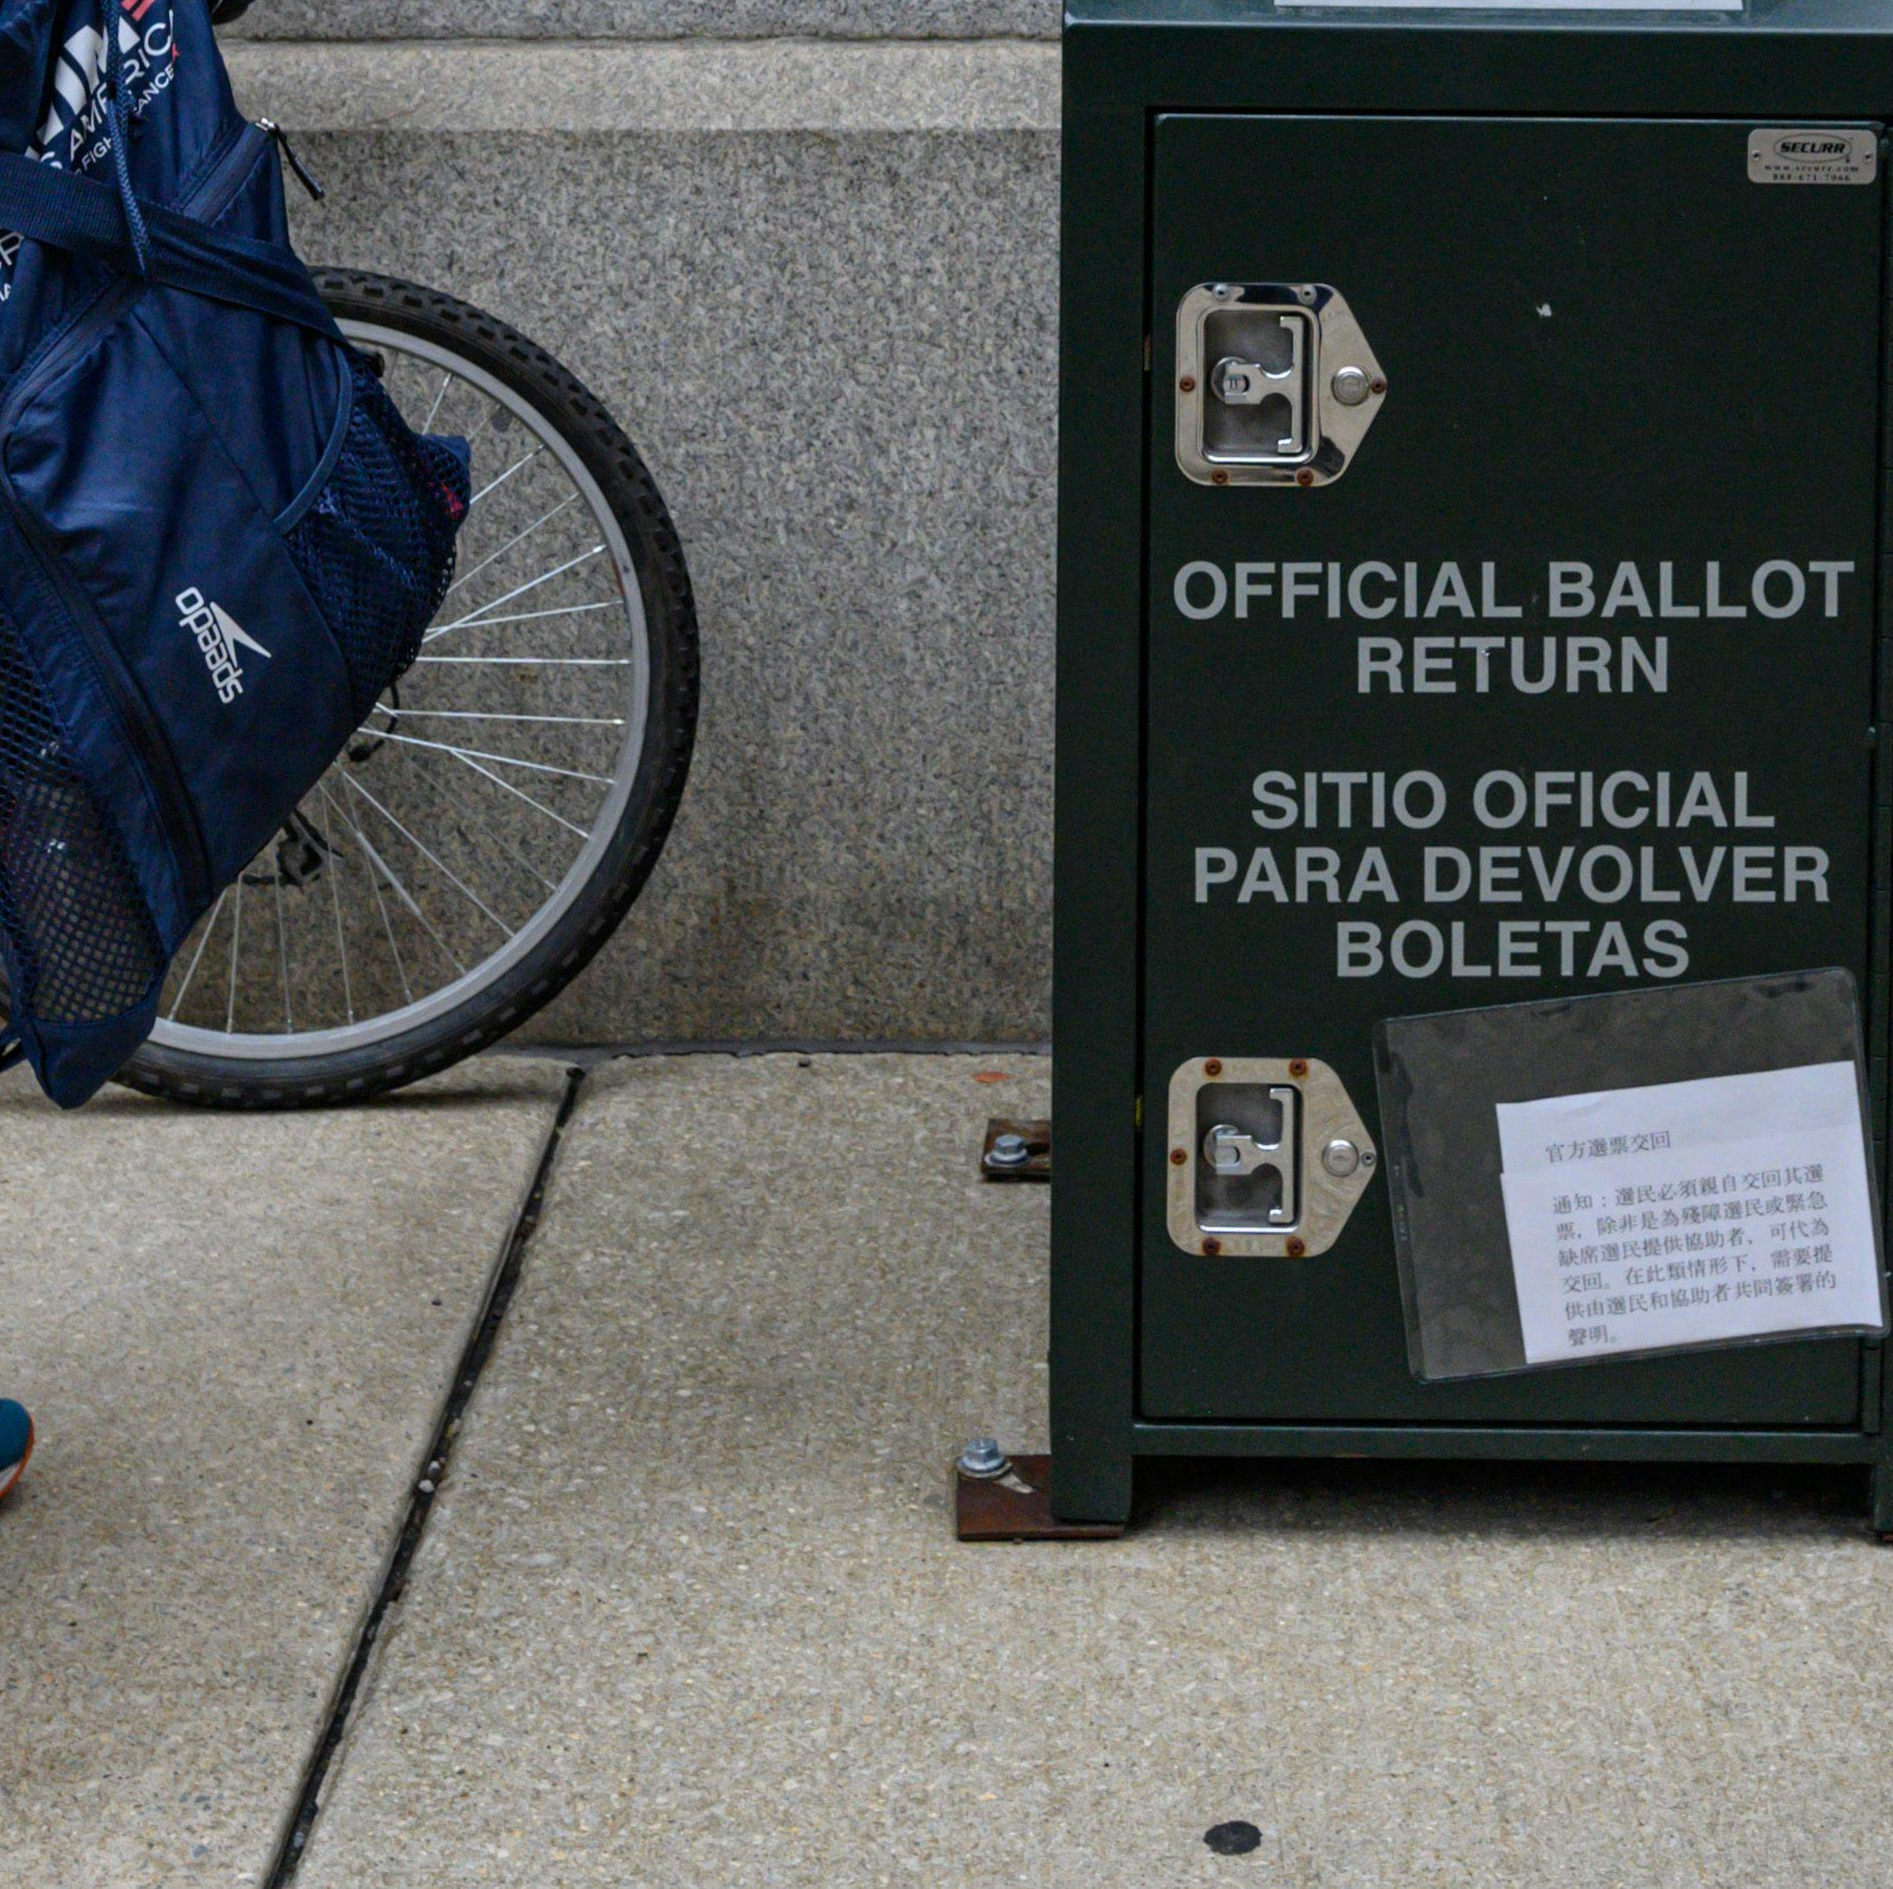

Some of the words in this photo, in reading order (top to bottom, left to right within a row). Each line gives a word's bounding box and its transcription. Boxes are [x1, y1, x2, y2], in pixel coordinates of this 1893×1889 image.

[1780, 142, 1845, 153] SECURR
[1173, 560, 1523, 619] OFFICIAL
[1548, 560, 1855, 619] BALLOT
[175, 586, 243, 703] speedo
[1357, 636, 1668, 694] RETURN
[1251, 770, 1447, 829] SITIO
[1473, 770, 1775, 829] OFICIAL
[1194, 846, 1400, 903] PARA
[1423, 845, 1830, 903] DEVOLVER
[1337, 919, 1689, 978] BOLETAS
[1545, 1130, 1671, 1164] 官方選票交回
